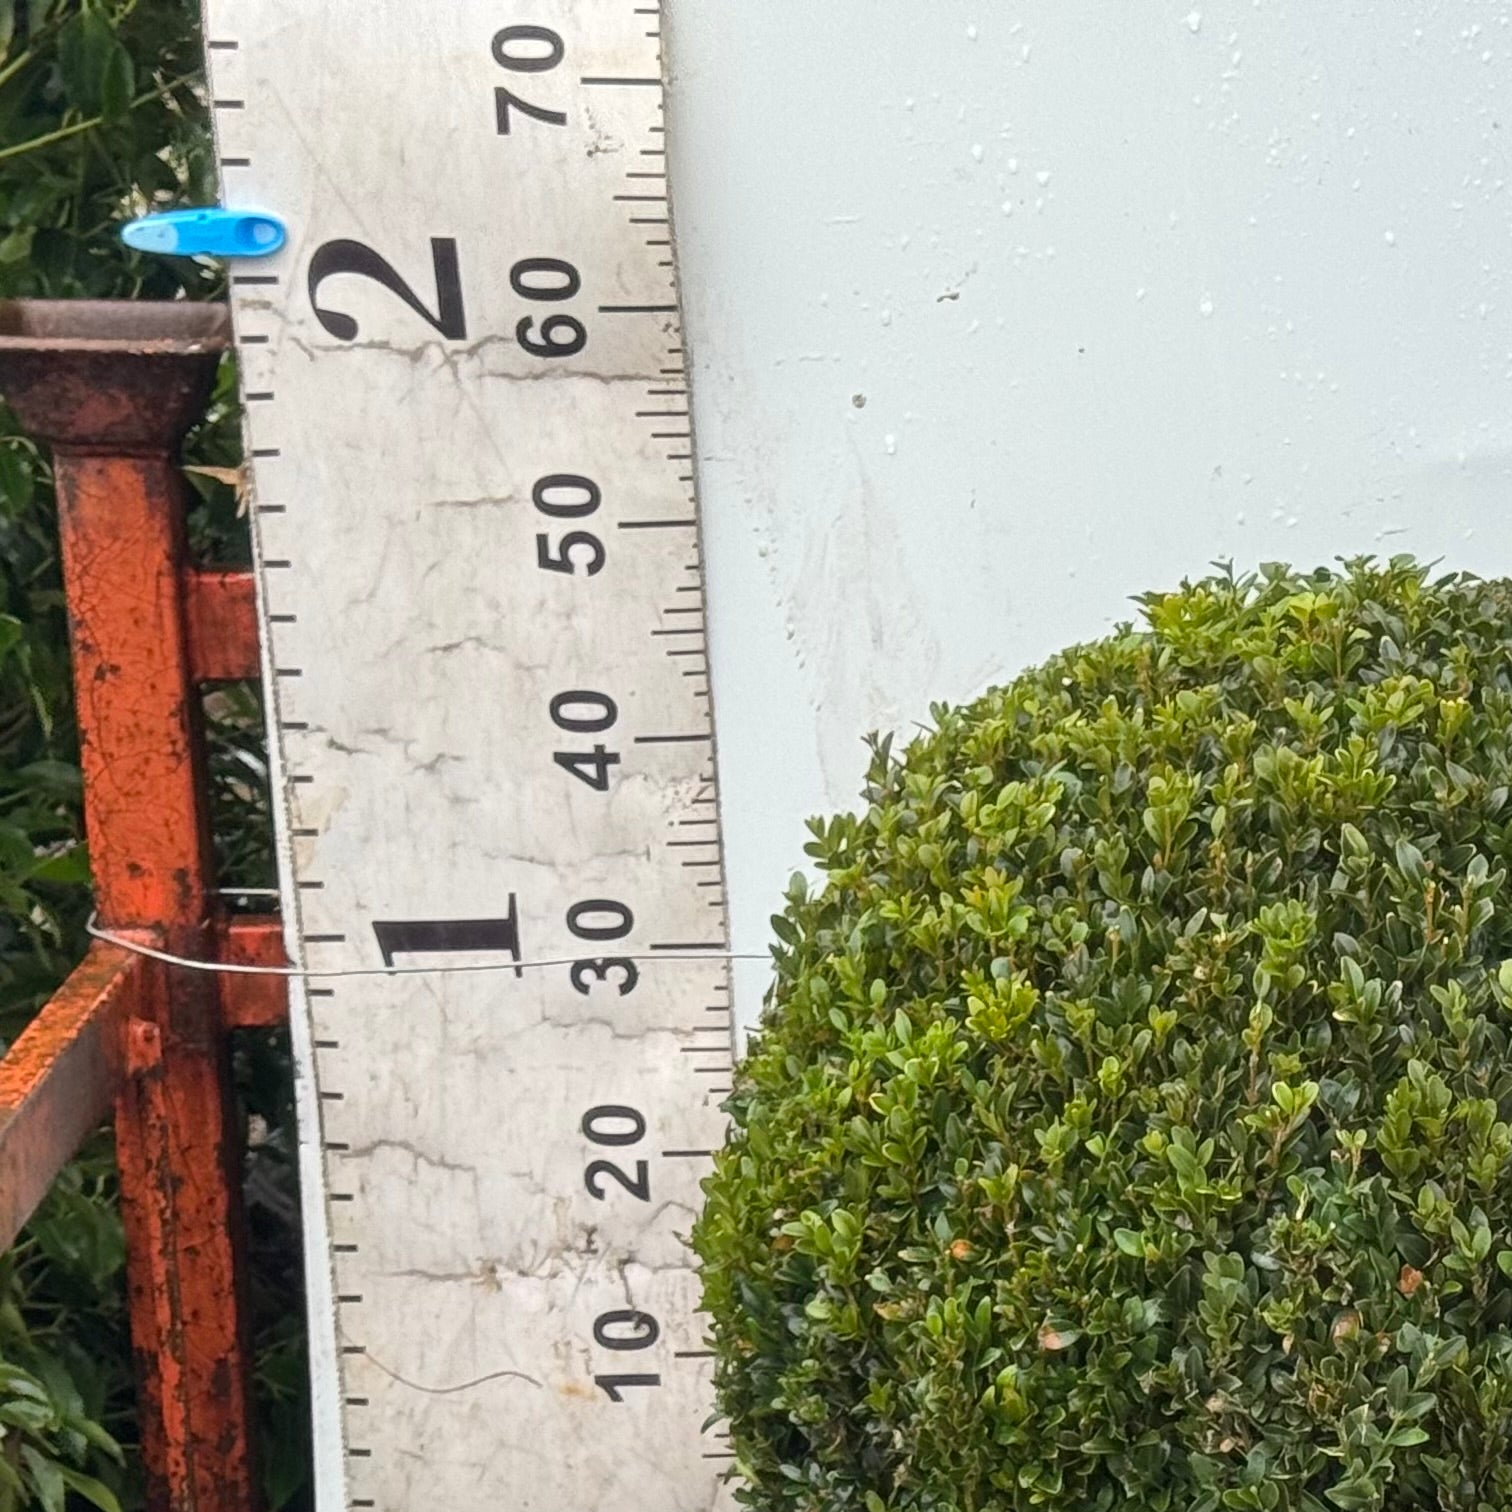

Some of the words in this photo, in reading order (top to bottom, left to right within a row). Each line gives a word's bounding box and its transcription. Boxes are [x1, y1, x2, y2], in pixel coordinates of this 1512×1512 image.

[491, 24, 567, 136] 70
[308, 237, 466, 341] 2
[509, 257, 587, 358] 60
[532, 473, 606, 576] 50
[549, 690, 621, 792] 40
[372, 892, 522, 978] 1
[566, 898, 639, 996] 30
[581, 1104, 651, 1203] 20
[593, 1309, 661, 1402] 10
